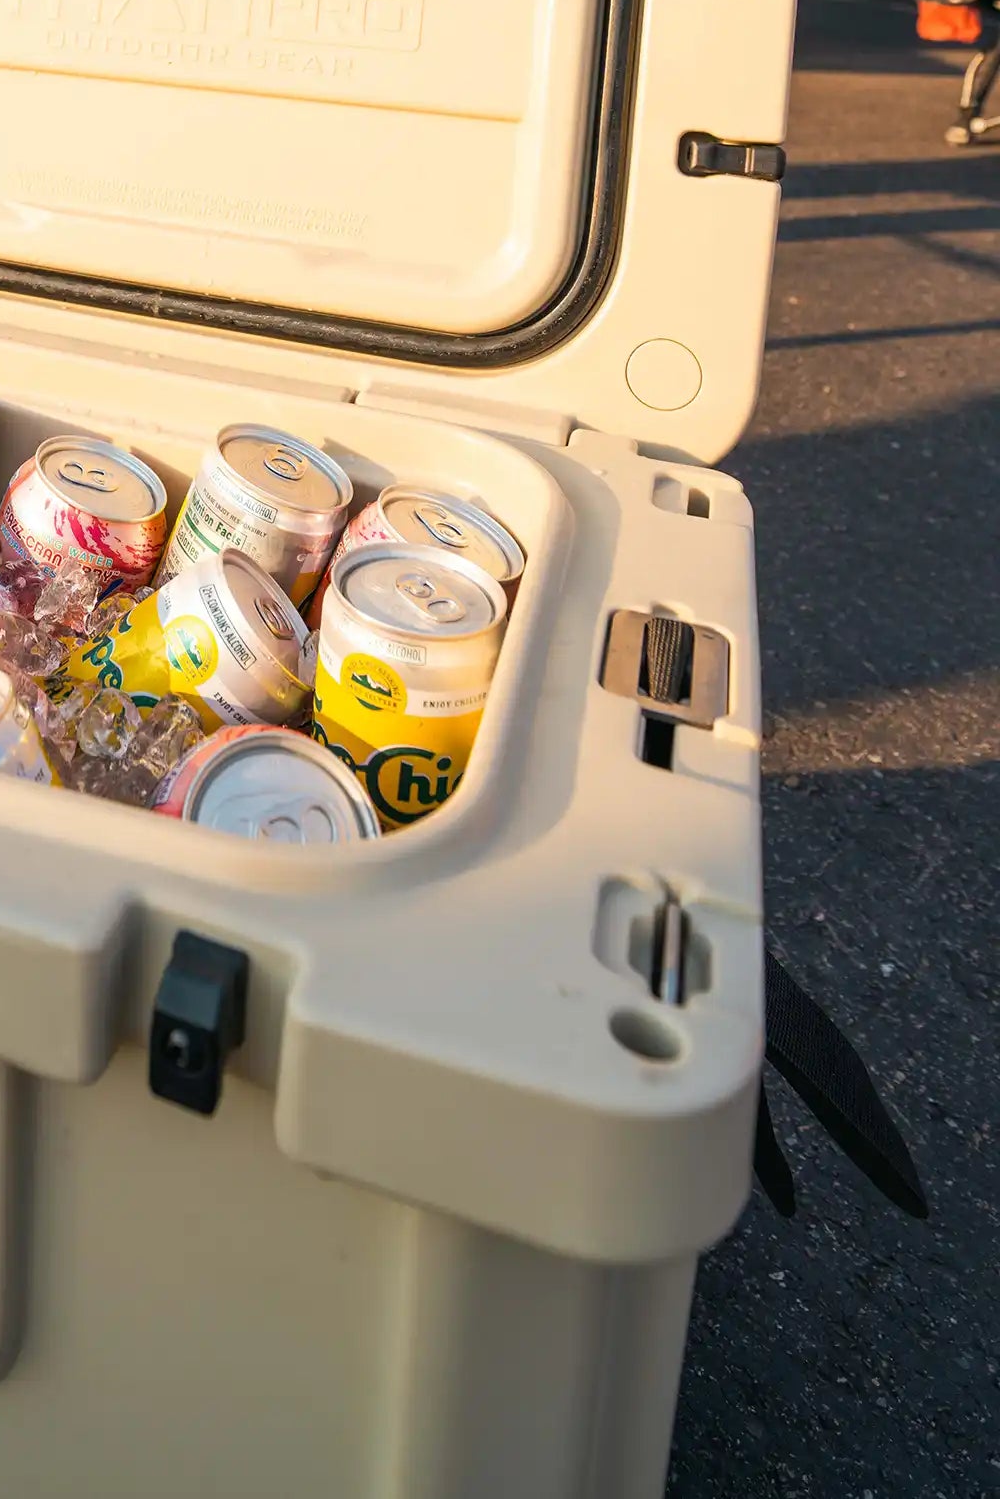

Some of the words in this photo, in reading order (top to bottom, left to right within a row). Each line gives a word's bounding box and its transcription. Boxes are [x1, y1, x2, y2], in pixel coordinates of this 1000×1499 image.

[243, 499, 274, 520] ALCOHOL
[215, 521, 242, 546] Facts
[229, 514, 268, 538] RESONSIBLY
[69, 545, 114, 568] WATER
[207, 598, 229, 634] CONTAINS
[224, 629, 252, 666] ALCOHOL
[387, 643, 423, 662] ALCOHOL
[213, 691, 233, 715] ENJOY
[423, 700, 452, 709] ENJOY
[366, 746, 465, 825] Chi
